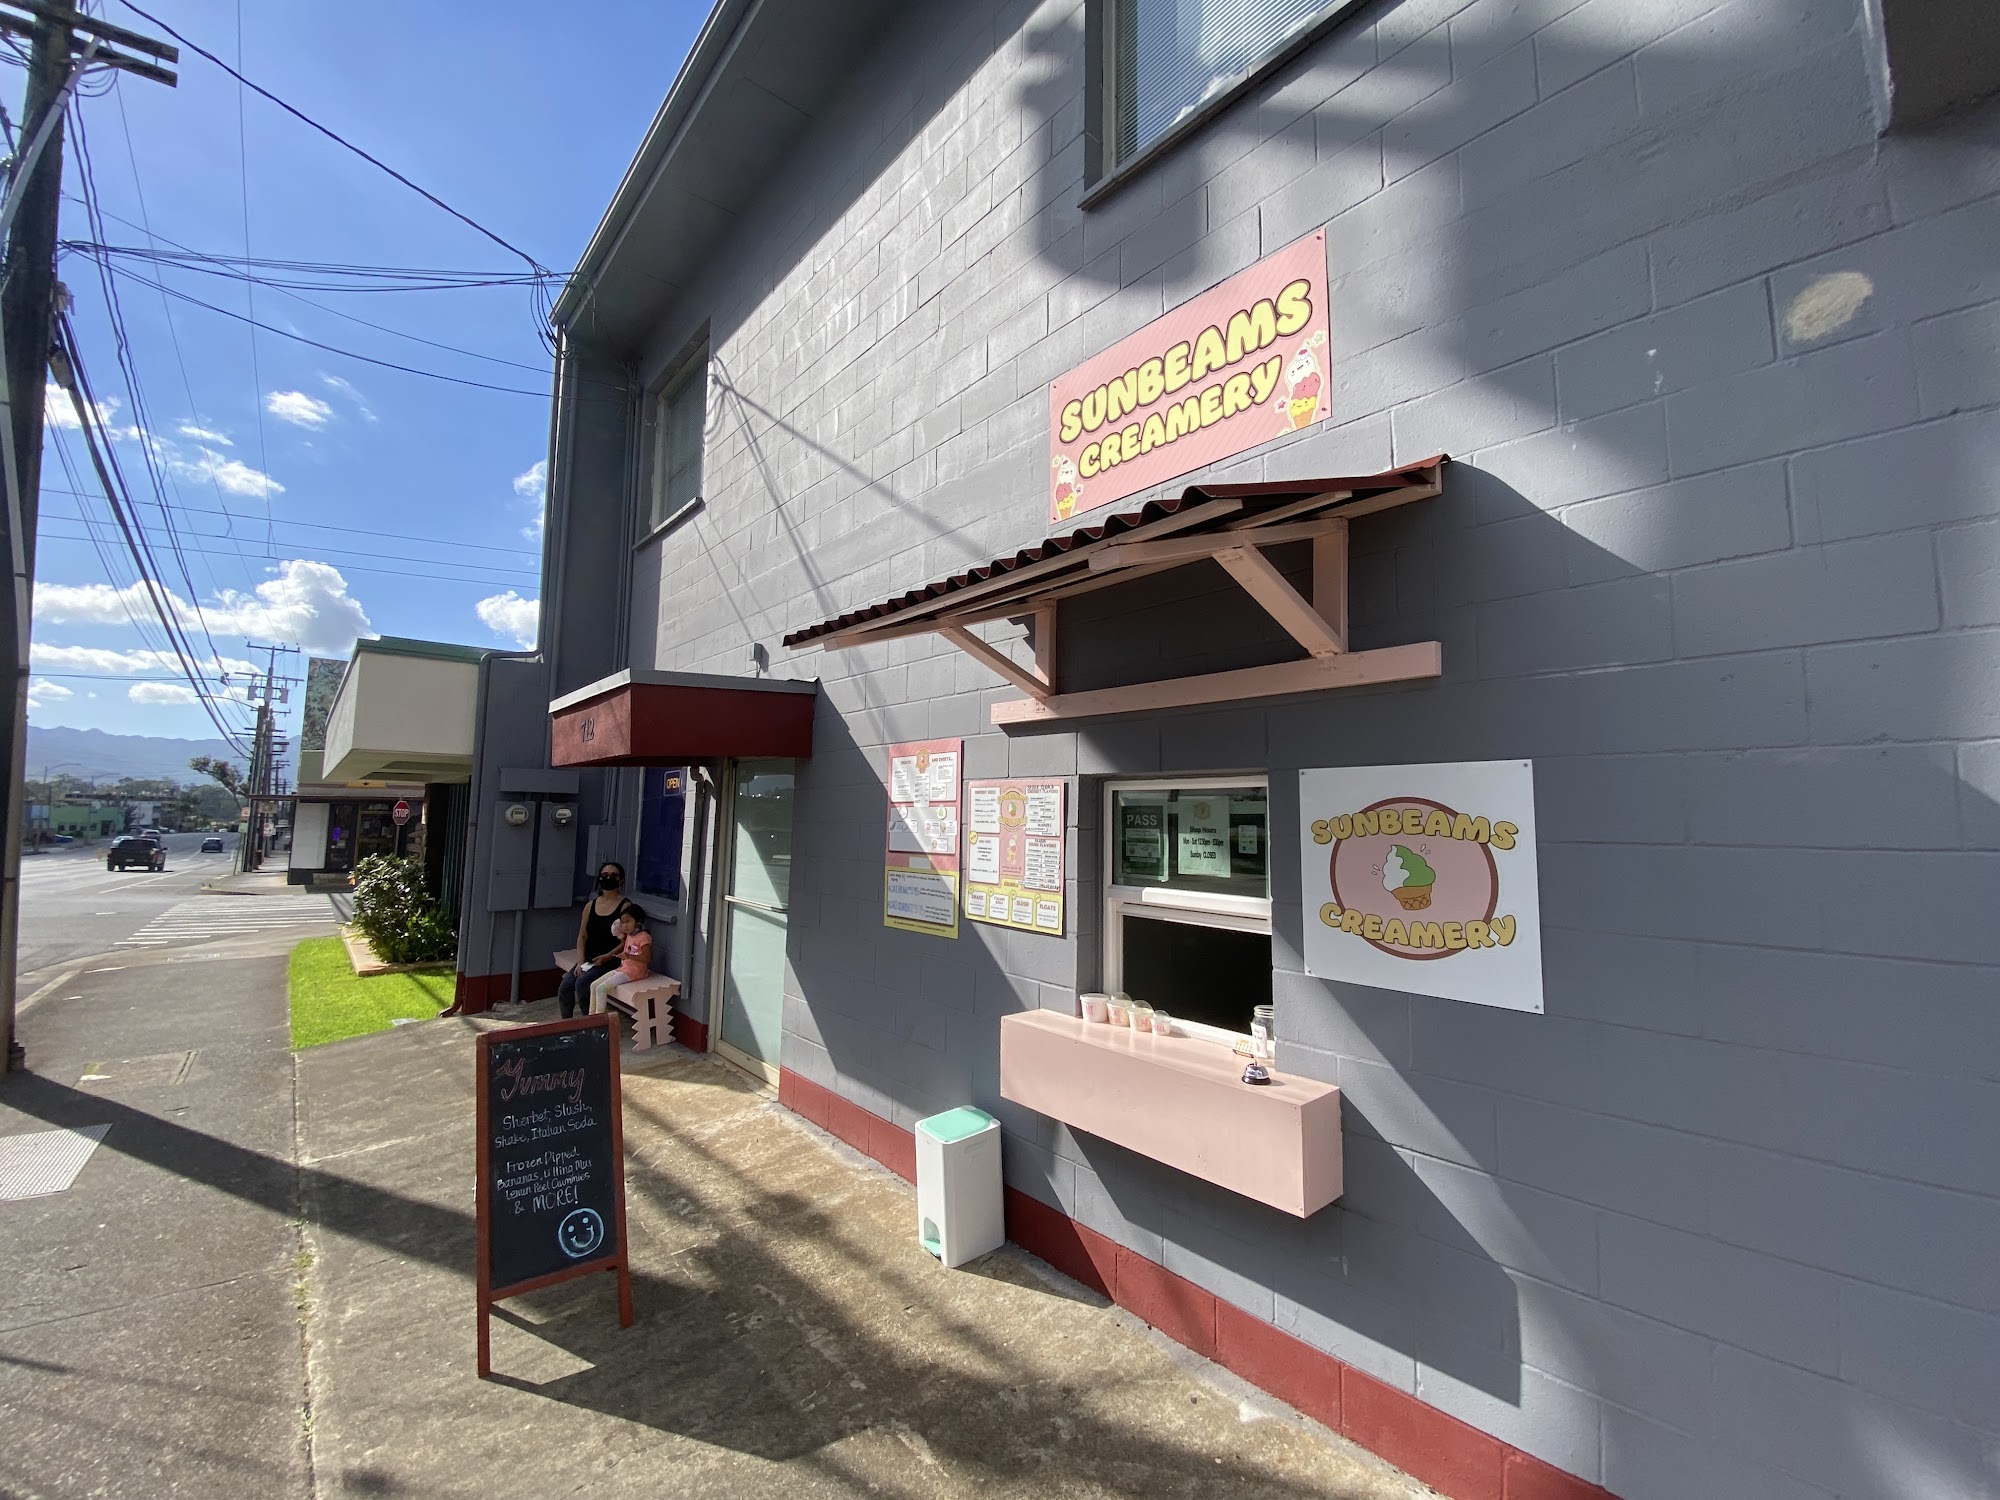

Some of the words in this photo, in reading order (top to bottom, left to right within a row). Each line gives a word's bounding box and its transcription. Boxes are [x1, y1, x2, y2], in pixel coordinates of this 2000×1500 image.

[1059, 278, 1313, 443] SUNBEAMS
[1078, 354, 1282, 479] CREAMERY
[580, 718, 595, 743] 712
[666, 777, 681, 789] OPEN
[394, 808, 409, 818] STOP
[1126, 814, 1157, 826] PASS
[1311, 809, 1519, 850] SUNBEAMS
[1203, 851, 1216, 859] CLOSED
[1319, 902, 1516, 950] CREAMERY
[497, 1057, 585, 1103] Yummy
[531, 1125, 567, 1140] Italian
[567, 1115, 597, 1131] Soda
[507, 1157, 543, 1173] Frozen
[544, 1146, 580, 1165] Dipped
[514, 1201, 525, 1214] &
[533, 1184, 578, 1213] MORE!
